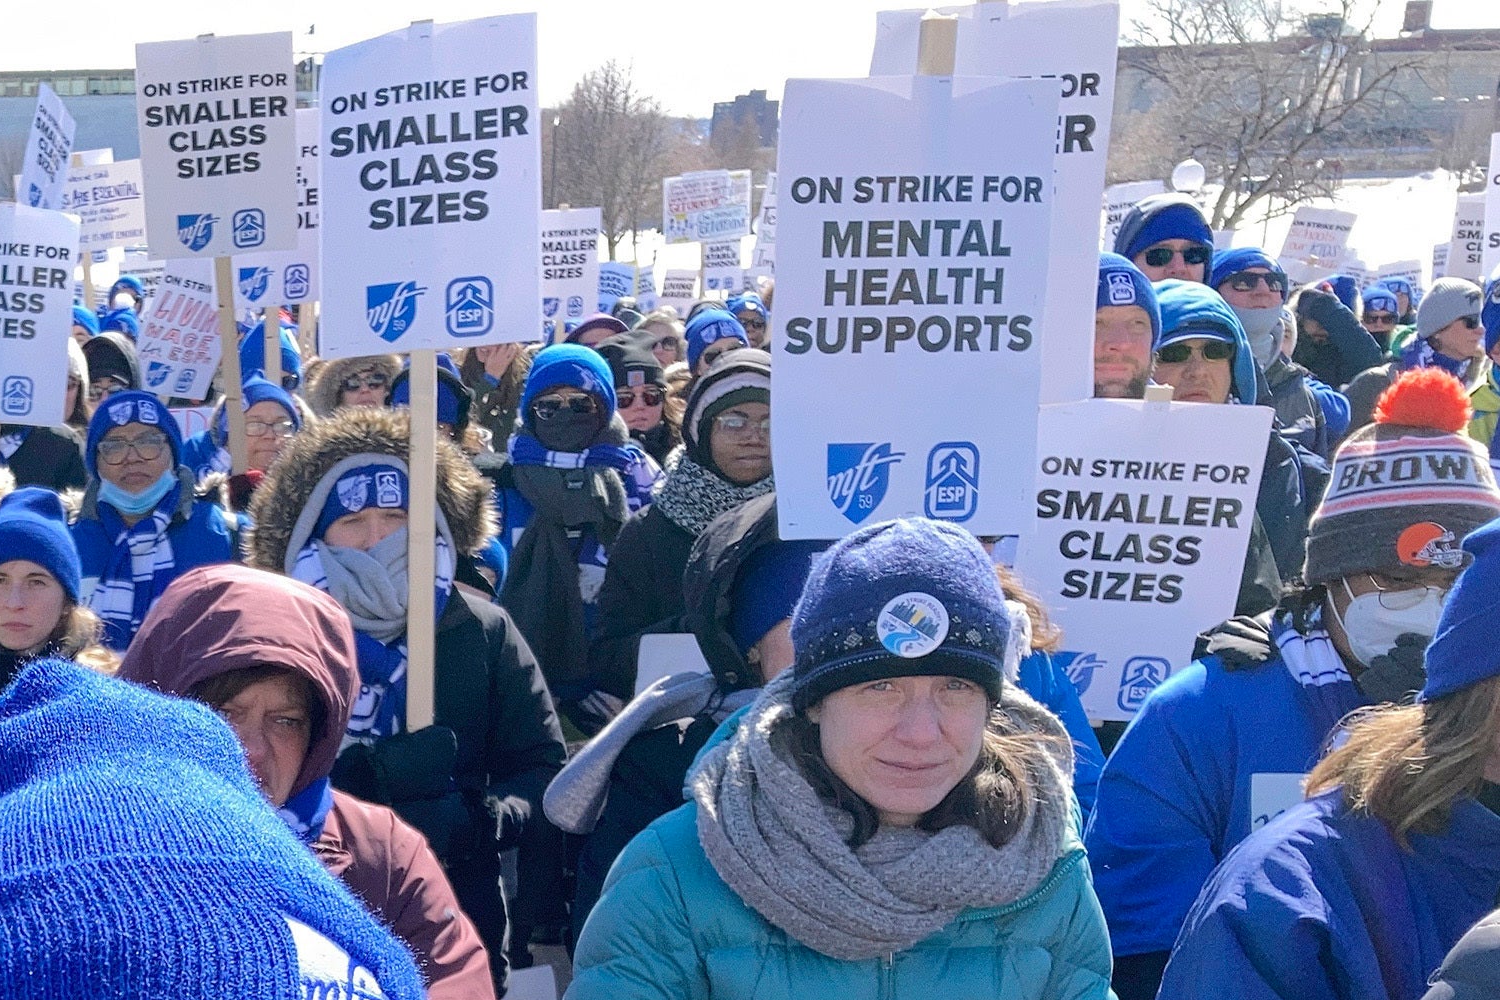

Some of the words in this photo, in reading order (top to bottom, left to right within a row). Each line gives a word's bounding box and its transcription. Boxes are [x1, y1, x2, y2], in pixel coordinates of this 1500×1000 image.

[144, 82, 171, 97] ON
[178, 76, 243, 94] STRIKE
[249, 73, 287, 87] FOR
[331, 92, 367, 115] ON
[375, 79, 466, 107] STRIKE
[475, 71, 528, 96] FOR
[1062, 73, 1100, 97] OR
[145, 96, 288, 128] SMALLER
[169, 124, 267, 153] CLASS
[330, 105, 528, 157] SMALLER
[177, 152, 261, 179] SIZES
[302, 146, 318, 157] FO
[360, 150, 498, 191] CLASS
[791, 176, 842, 203] ON
[853, 175, 973, 202] STRIKE
[983, 175, 1043, 202] FOR
[368, 190, 489, 230] SIZES
[1459, 219, 1474, 227] ON
[548, 229, 578, 238] STRIKE
[581, 228, 597, 236] FOR
[822, 219, 1011, 258] MENTAL
[1307, 222, 1334, 231] STRIKE
[35, 245, 69, 260] FOR
[542, 239, 596, 252] MALLER
[542, 254, 587, 266] CLASS
[544, 268, 583, 280] SIZES
[165, 275, 180, 286] ON
[824, 268, 1004, 306] HEALTH
[457, 309, 481, 323] ESP
[145, 323, 214, 349] WAGE
[784, 315, 1033, 353] SUPPORTS
[828, 443, 906, 515] mft
[1041, 456, 1082, 477] ON
[1090, 459, 1185, 481] STRIKE
[1193, 464, 1250, 485] FOR
[1337, 453, 1482, 492] BROW
[858, 495, 873, 509] 59
[938, 487, 964, 502] ESP
[1037, 489, 1243, 529] SMALLER
[1059, 530, 1202, 566] CLASS
[1060, 569, 1184, 604] SIZES
[1067, 652, 1107, 686] ft
